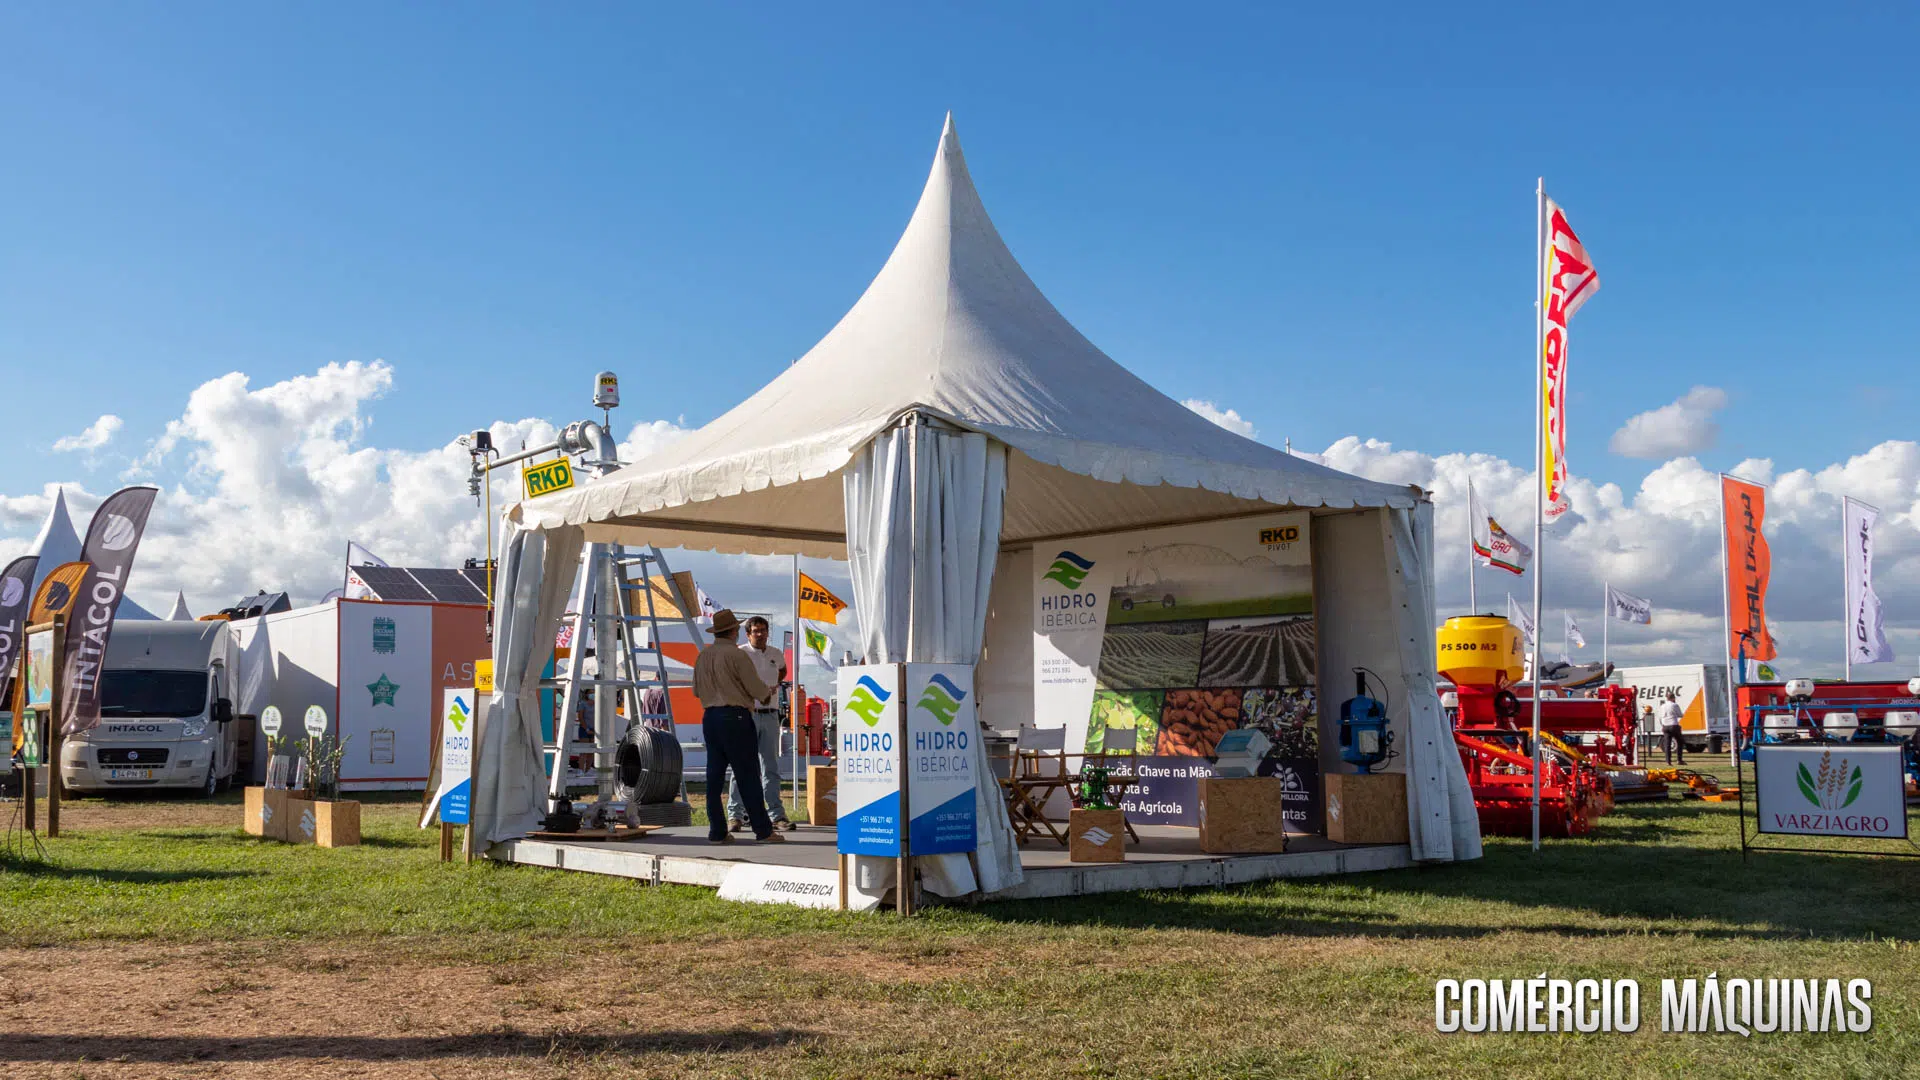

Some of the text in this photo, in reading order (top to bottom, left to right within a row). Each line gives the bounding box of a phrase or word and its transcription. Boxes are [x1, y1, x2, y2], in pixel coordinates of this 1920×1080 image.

[528, 465, 569, 493] RKD
[1261, 528, 1298, 542] RKD
[1267, 543, 1291, 551] PIVOT
[1490, 538, 1512, 554] GRO
[1042, 593, 1096, 610] HIDRO
[1041, 611, 1097, 627] IBÉRICA
[72, 565, 122, 690] INTACOL
[0, 619, 15, 679] COL
[1455, 643, 1477, 651] 500
[1480, 643, 1497, 651] M2
[443, 662, 456, 681] A
[1637, 685, 1683, 700] ELLENC
[108, 725, 163, 733] INTACOL
[446, 736, 469, 750] HIDRO
[844, 732, 893, 751] HIDRO
[916, 731, 968, 750] HIDRO
[844, 753, 893, 773] IBÉRICA
[916, 752, 969, 772] IBÉRICA
[1139, 765, 1170, 777] Chave
[1173, 767, 1187, 777] na
[1189, 765, 1211, 778] Mão
[1143, 785, 1150, 794] e
[1139, 800, 1182, 815] Agrícola
[1775, 813, 1889, 832] VARZIAGRO
[762, 880, 834, 896] HIDROIBERICA
